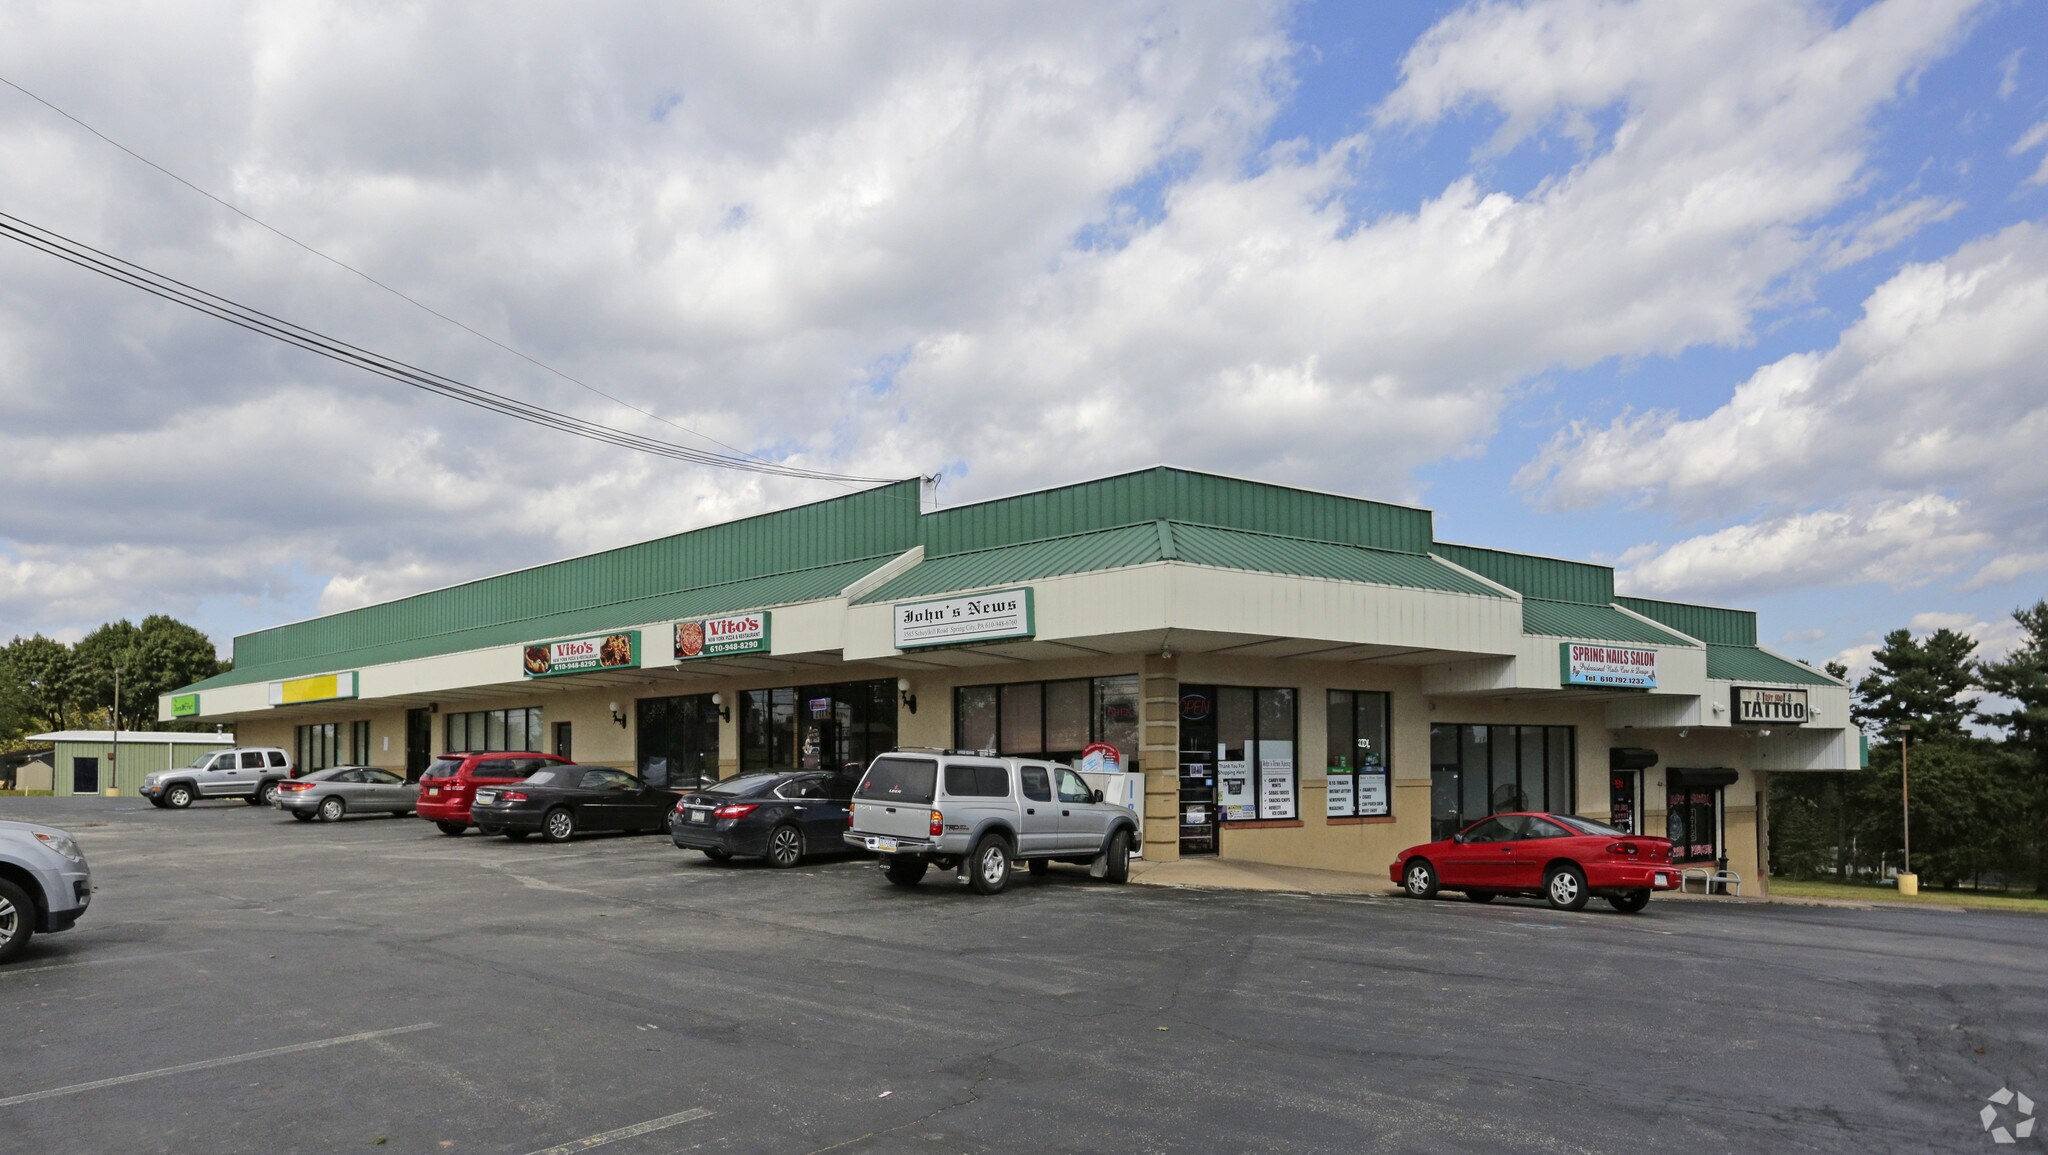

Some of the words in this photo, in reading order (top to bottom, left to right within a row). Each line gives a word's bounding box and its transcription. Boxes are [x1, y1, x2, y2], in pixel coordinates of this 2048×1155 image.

[903, 604, 961, 623] John's
[967, 600, 1017, 616] News
[708, 617, 759, 636] Vito's
[950, 625, 965, 633] Spring
[738, 631, 760, 639] RESTAURANT
[556, 641, 594, 657] Vito's
[709, 640, 758, 653] 610-948-8290
[1572, 645, 1605, 663] SPRING
[1605, 648, 1629, 665] NAILS
[1630, 650, 1655, 667] SALON
[554, 660, 597, 671] 610-948-8290
[1579, 662, 1606, 673] Professional
[1600, 676, 1645, 685] 610.792.1232
[1179, 699, 1210, 715] OPEN
[1742, 701, 1804, 719] TATTOO
